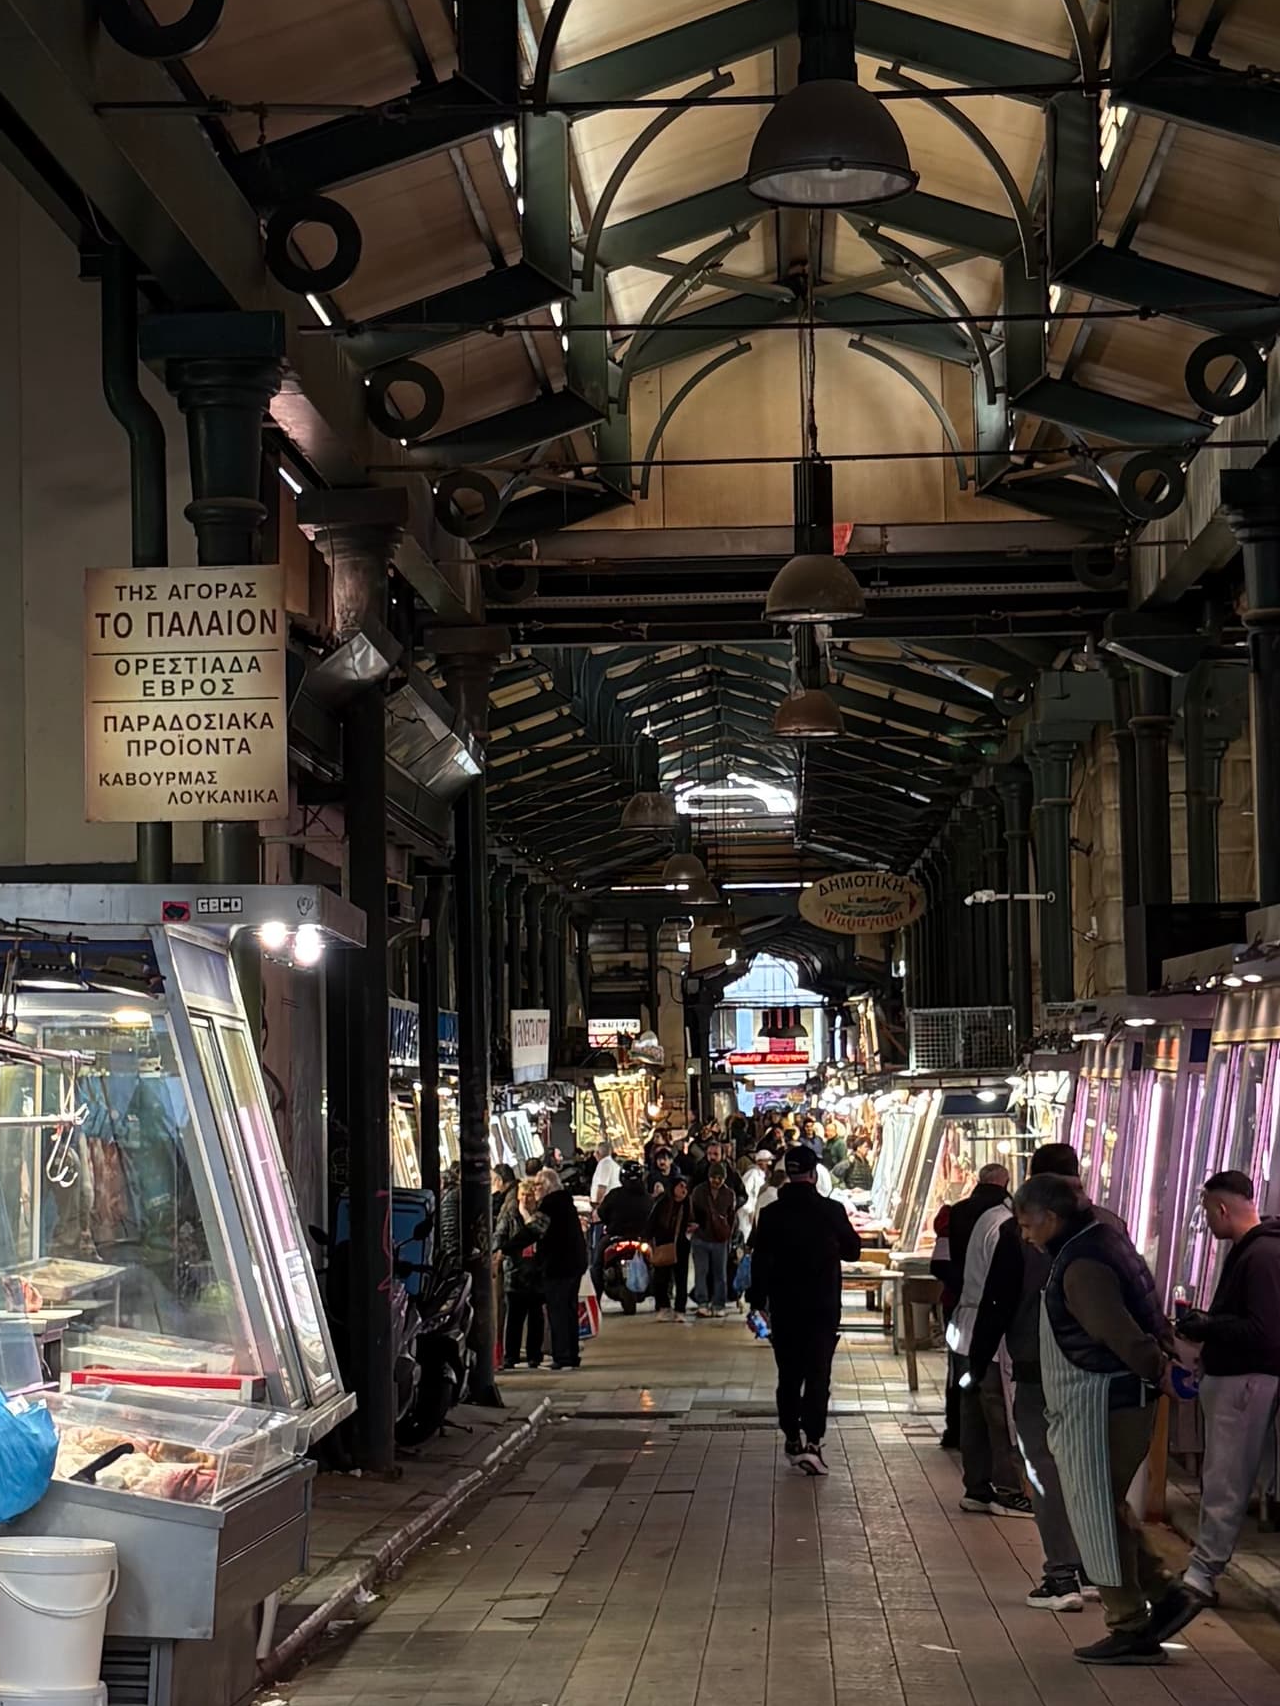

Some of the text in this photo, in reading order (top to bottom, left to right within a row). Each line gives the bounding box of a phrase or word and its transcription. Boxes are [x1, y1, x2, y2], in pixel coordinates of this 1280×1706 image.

[114, 582, 257, 602] ΤΗΣ ΑΓΟΡΑΣ
[95, 608, 278, 639] ΤΟ ΠΑΛΑΙΟΝ
[114, 656, 262, 676] ΟΡΕΣΤΙΑΔΑ
[142, 678, 235, 697] ΕΒΡΟΣ
[103, 712, 274, 733] ΠΑΡΑΔΟΣΙΑΚΑ
[127, 734, 252, 757] ΠΡΟΪΟΝΤΑ
[99, 771, 218, 787] ΚΑΒΟΥΡΜΑΣ
[167, 790, 279, 806] ΛΟΥΚΑΝΙΚΑ
[819, 875, 905, 897] ΔΗΜΟΤΙΚΗ
